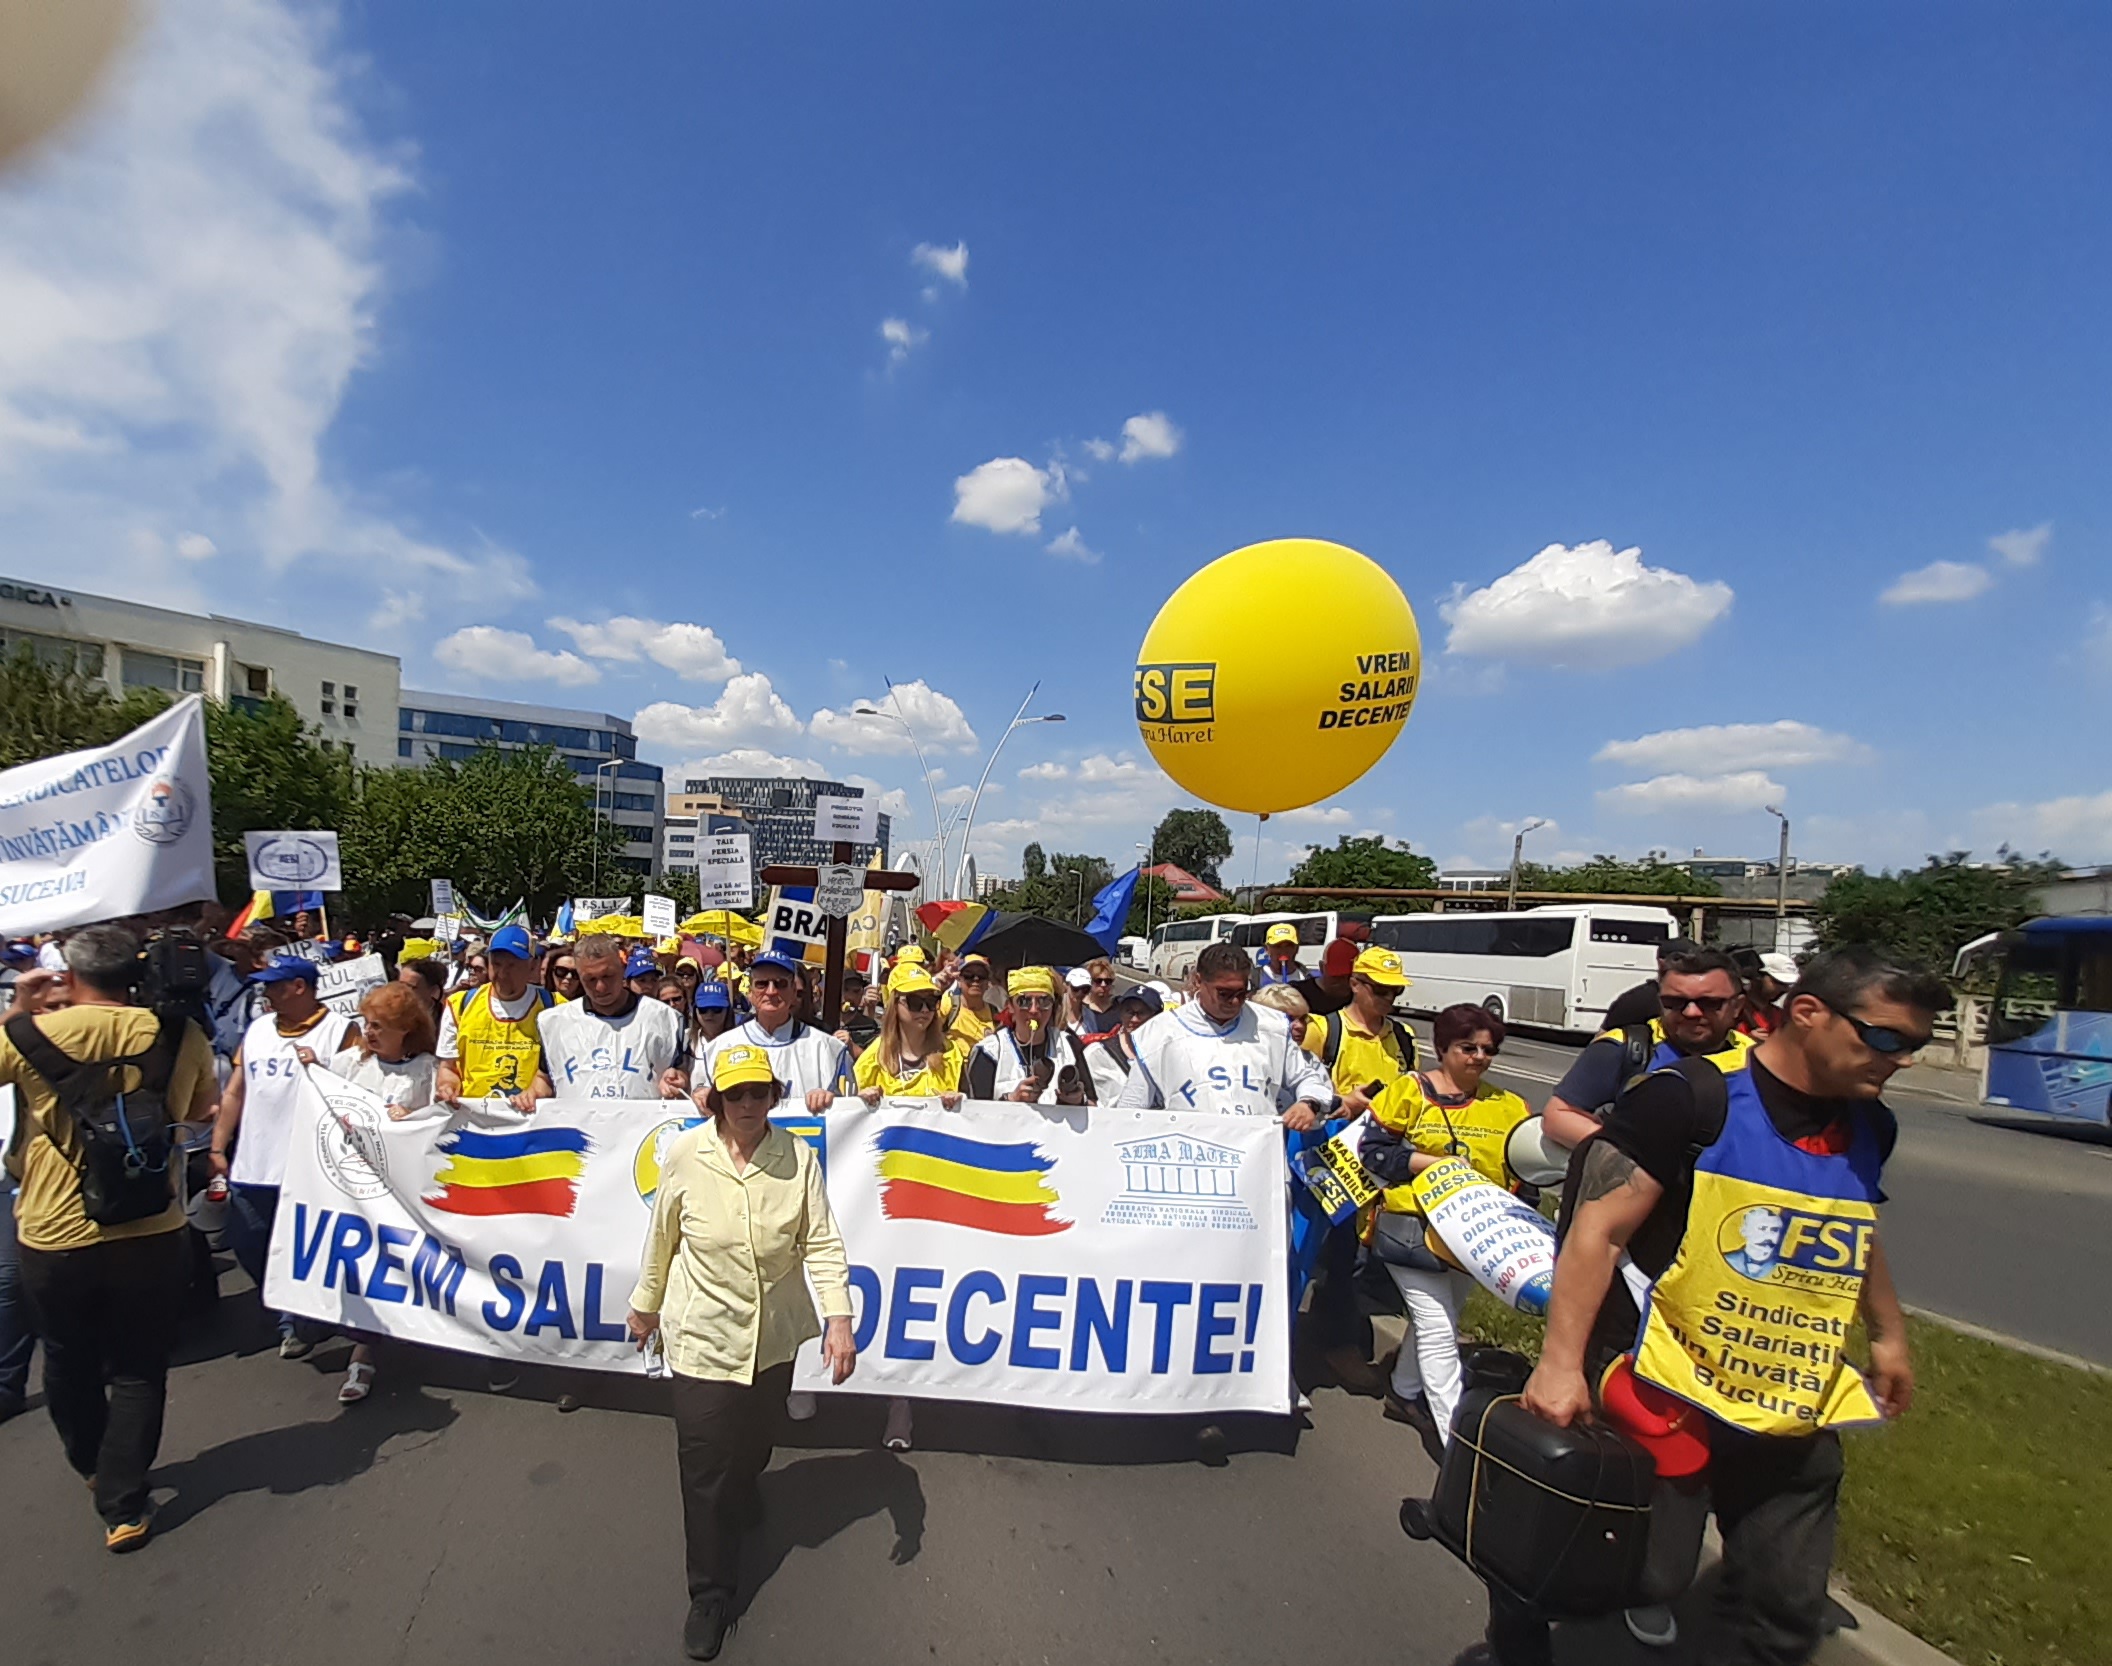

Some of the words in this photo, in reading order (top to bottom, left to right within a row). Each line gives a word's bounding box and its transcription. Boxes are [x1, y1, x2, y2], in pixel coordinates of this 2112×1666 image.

[1356, 651, 1410, 675] VREM
[1339, 676, 1414, 702] SALARII
[1459, 1189, 1491, 1205] MAI
[1469, 1225, 1532, 1261] PENTRU
[1481, 1238, 1544, 1278] SALARIU
[1517, 1252, 1544, 1270] DE
[292, 1202, 467, 1318] VREM
[482, 1252, 638, 1343] SAL
[821, 1264, 1264, 1375] DECENTE!
